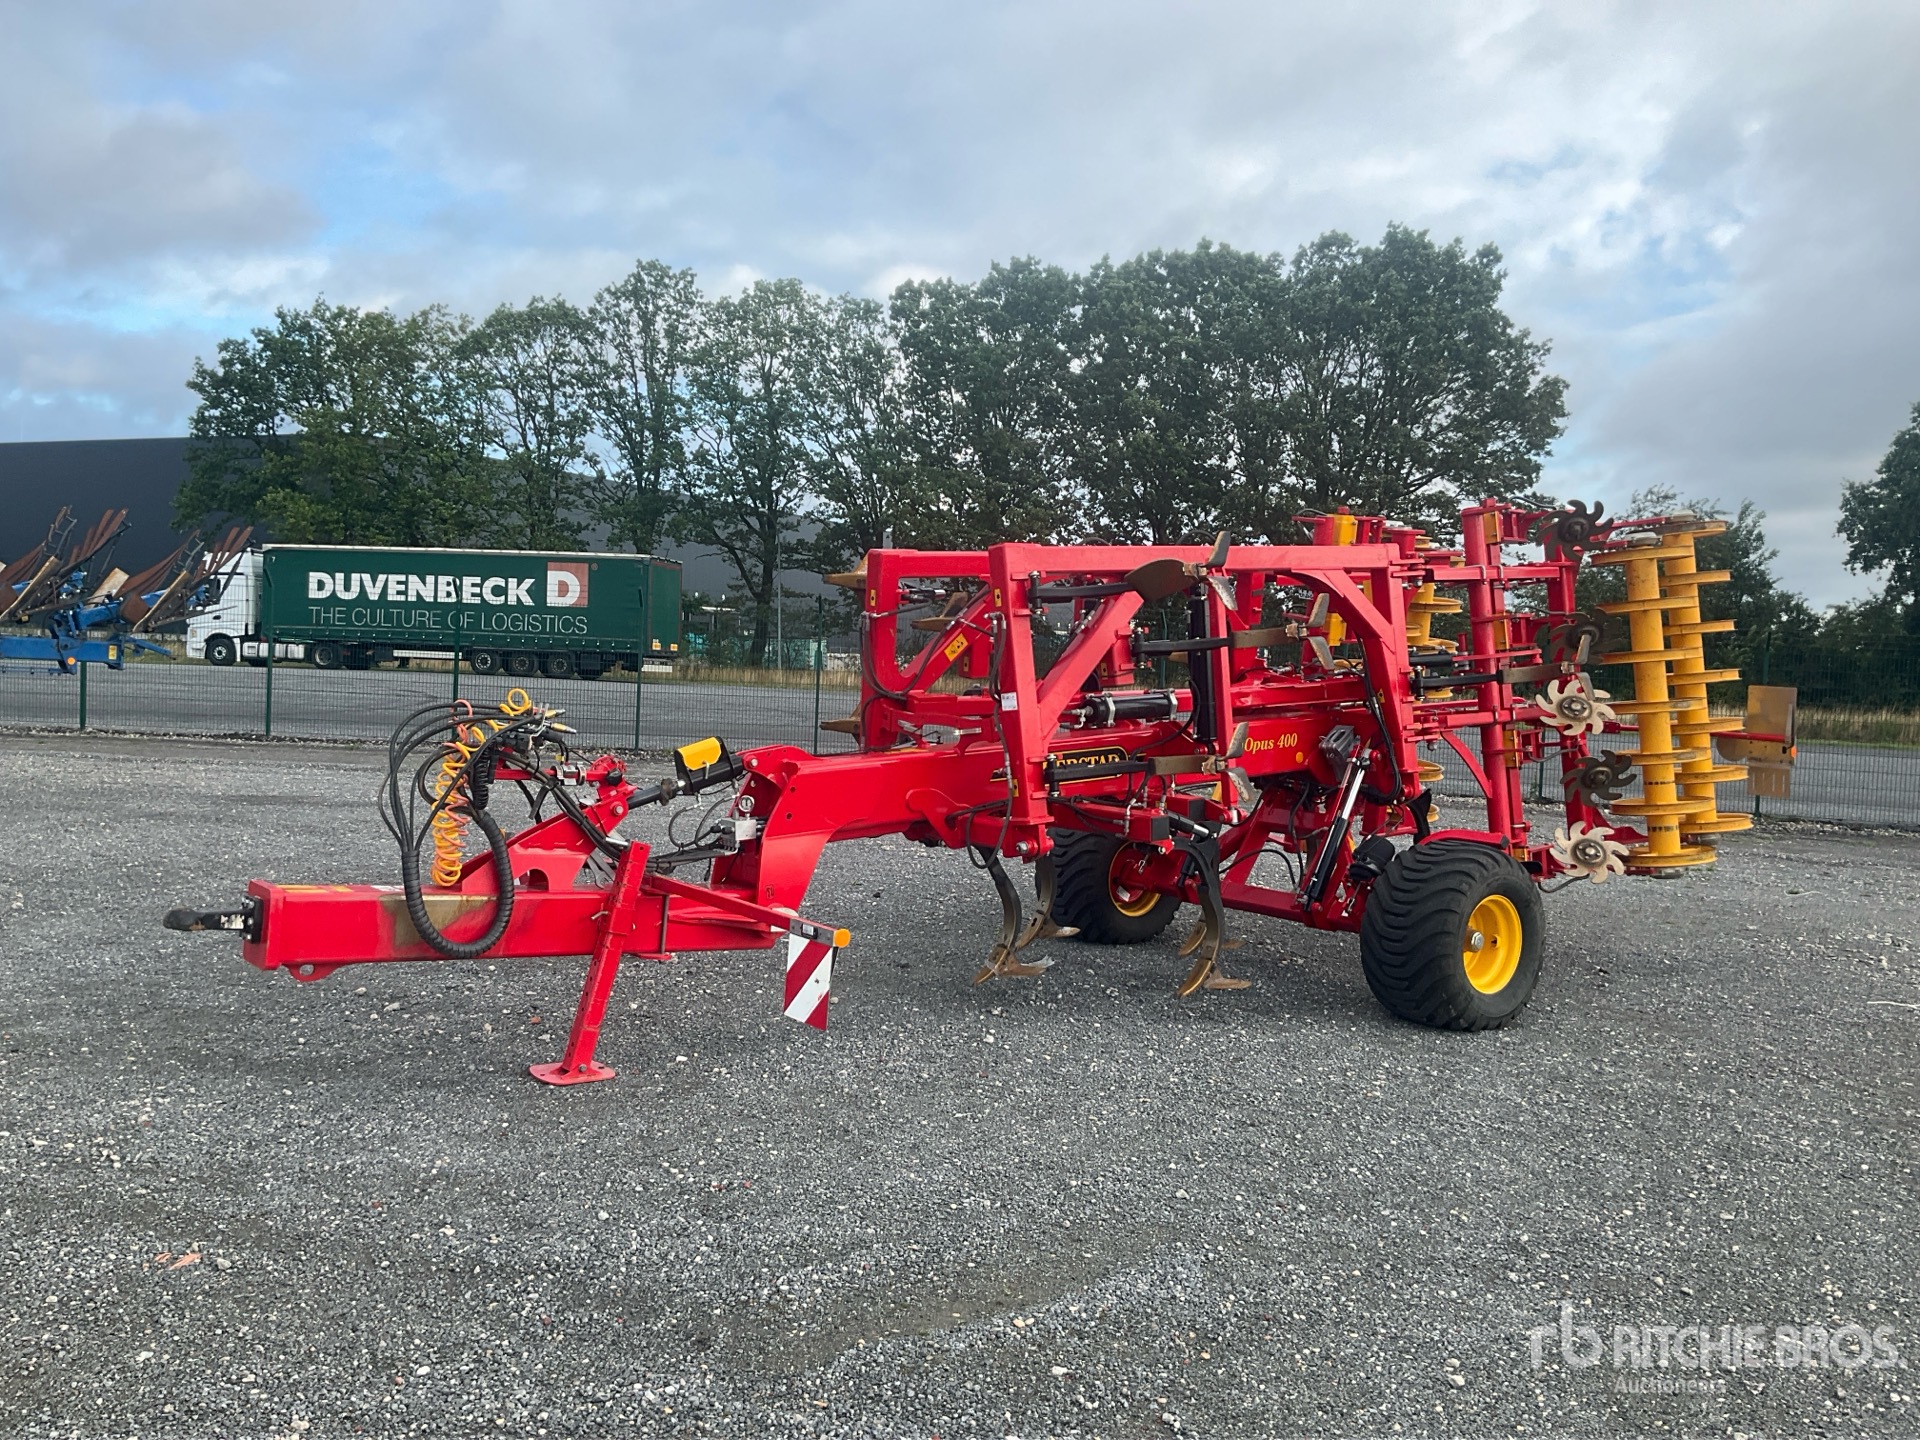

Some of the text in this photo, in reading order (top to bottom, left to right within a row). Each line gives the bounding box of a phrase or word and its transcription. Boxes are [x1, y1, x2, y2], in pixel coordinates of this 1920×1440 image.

[308, 571, 536, 606] DUVENBECK
[308, 606, 588, 634] THE CULTURE OF LOGISTICS
[1244, 733, 1298, 755] Opus 400
